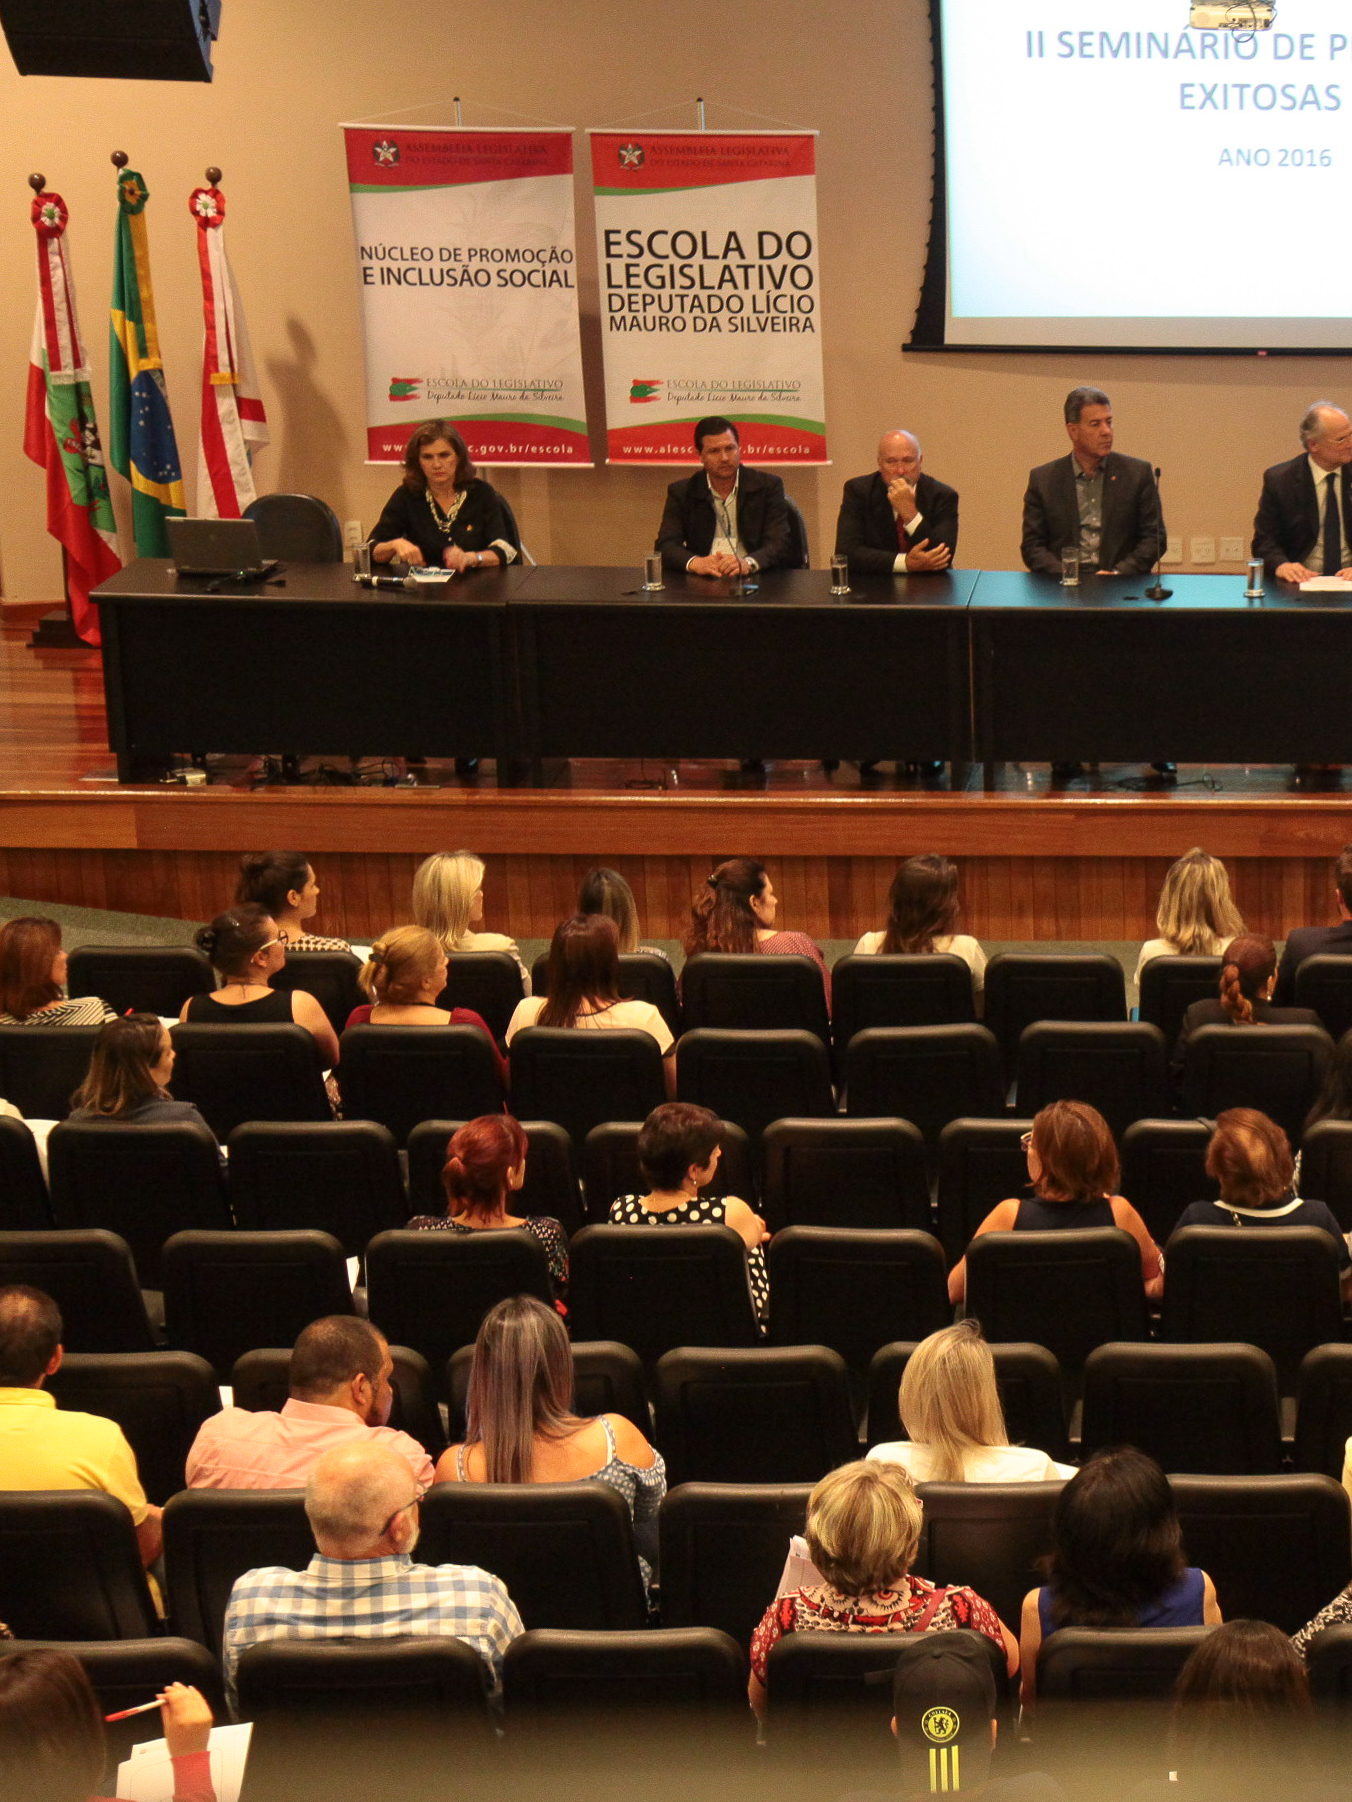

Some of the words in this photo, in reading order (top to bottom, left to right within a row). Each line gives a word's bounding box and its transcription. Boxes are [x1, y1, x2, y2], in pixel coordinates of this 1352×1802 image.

[1025, 30, 1045, 58] II
[1057, 25, 1259, 61] SEMINÁRIO
[1272, 33, 1316, 61] DE
[1178, 82, 1341, 111] EXITOSAS
[1218, 148, 1271, 167] ANO
[1277, 148, 1333, 168] 2016
[360, 243, 434, 261] NÚCLEO
[439, 247, 463, 263] DE
[468, 246, 573, 267] PROMOÇÃO
[604, 229, 746, 260] ESCOLA
[757, 230, 812, 260] DO
[362, 266, 375, 285] E
[381, 264, 492, 287] INCLUSÃO
[496, 268, 575, 288] SOCIAL
[606, 263, 813, 290] LEGISLATIVO
[608, 293, 744, 314] DEPUTADO
[752, 289, 815, 314] LÍCIO
[610, 315, 687, 332] MAURO
[693, 316, 722, 333] DA
[728, 316, 815, 333] SILVEIRA
[426, 378, 468, 388] ESCOLA
[471, 379, 489, 388] DO
[493, 379, 563, 389] LEGISLATIVO
[667, 379, 708, 389] ESCOLA
[711, 380, 728, 389] DO
[732, 380, 801, 389] LEGISLATIVO
